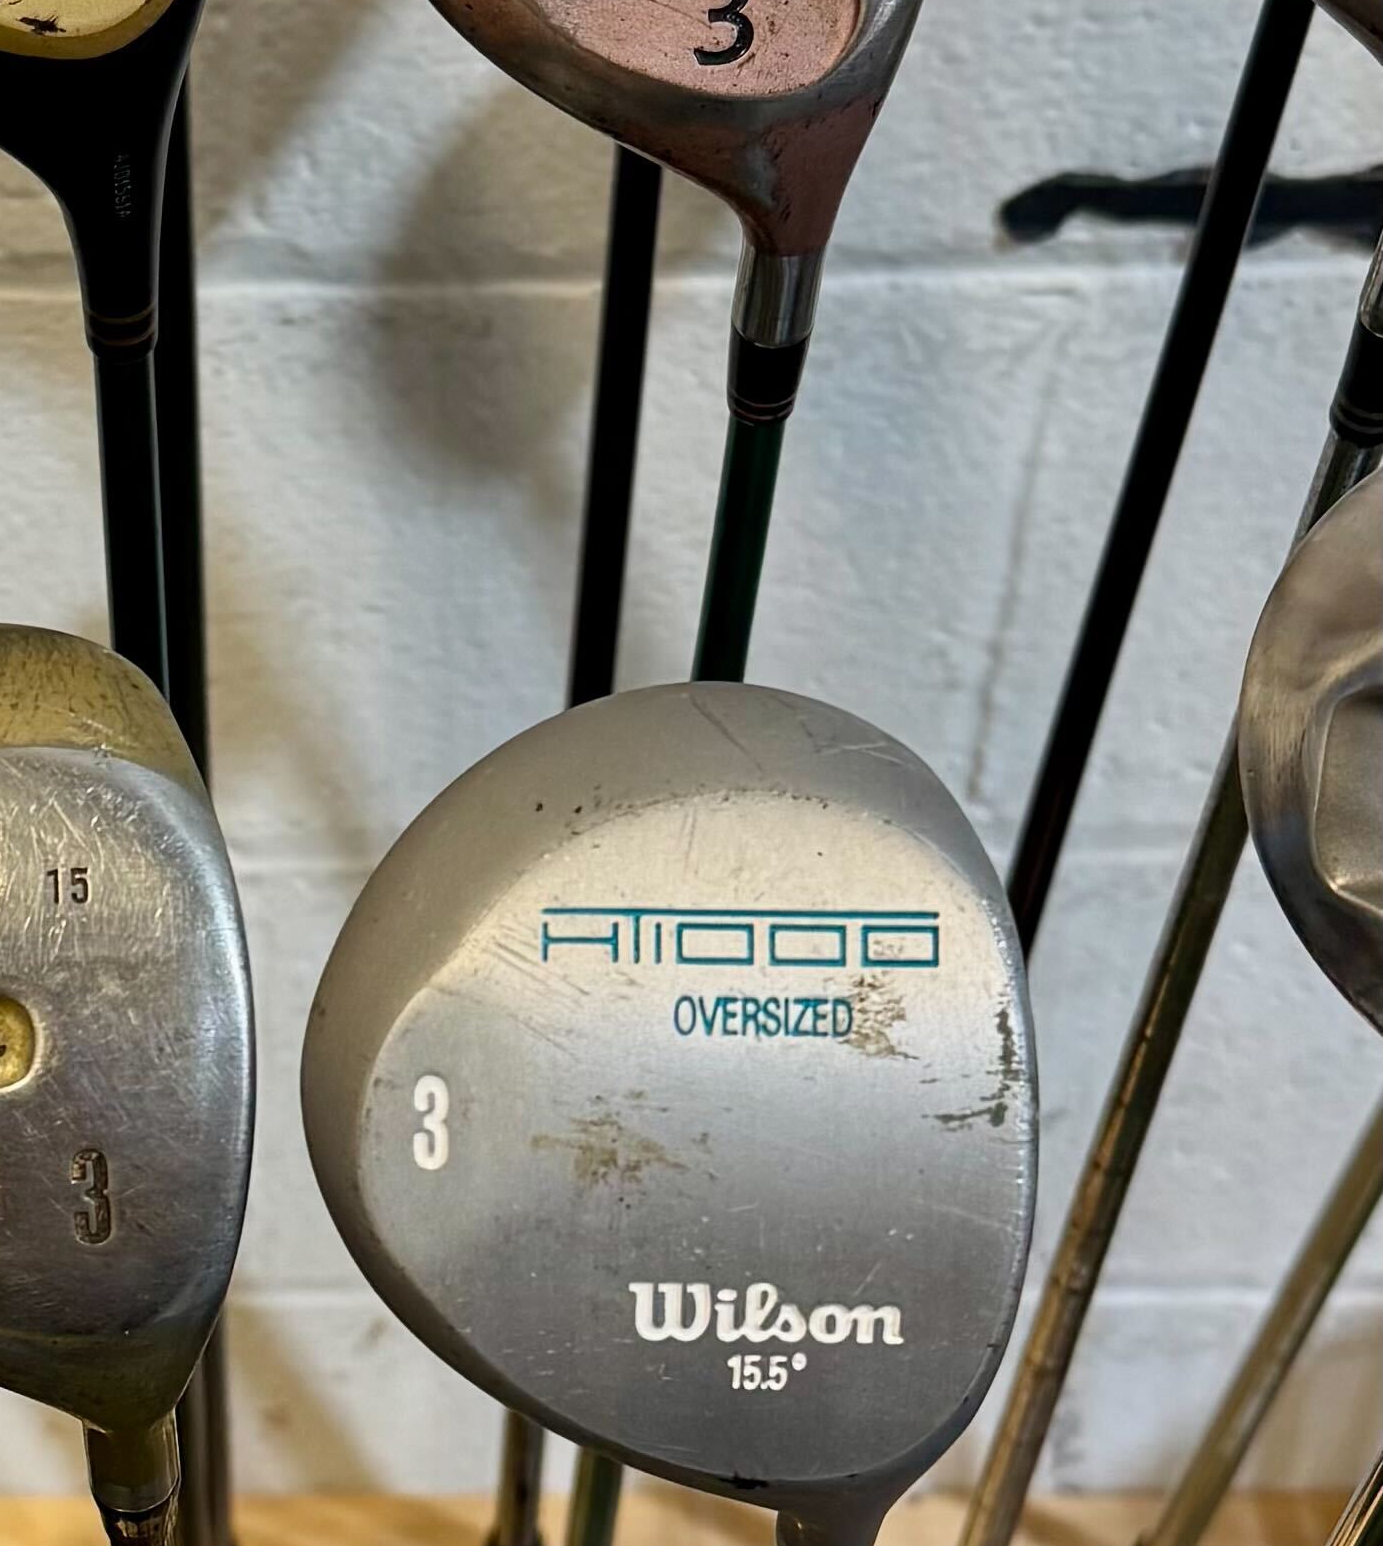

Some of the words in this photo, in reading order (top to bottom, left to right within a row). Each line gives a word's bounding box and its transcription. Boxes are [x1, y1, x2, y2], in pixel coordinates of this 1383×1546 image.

[46, 867, 90, 905] 15
[674, 995, 853, 1037] OVERSIZED
[413, 1075, 450, 1171] 3
[70, 1148, 111, 1245] 3
[628, 1281, 905, 1346] Wilson
[727, 1353, 808, 1391] 15.5°
